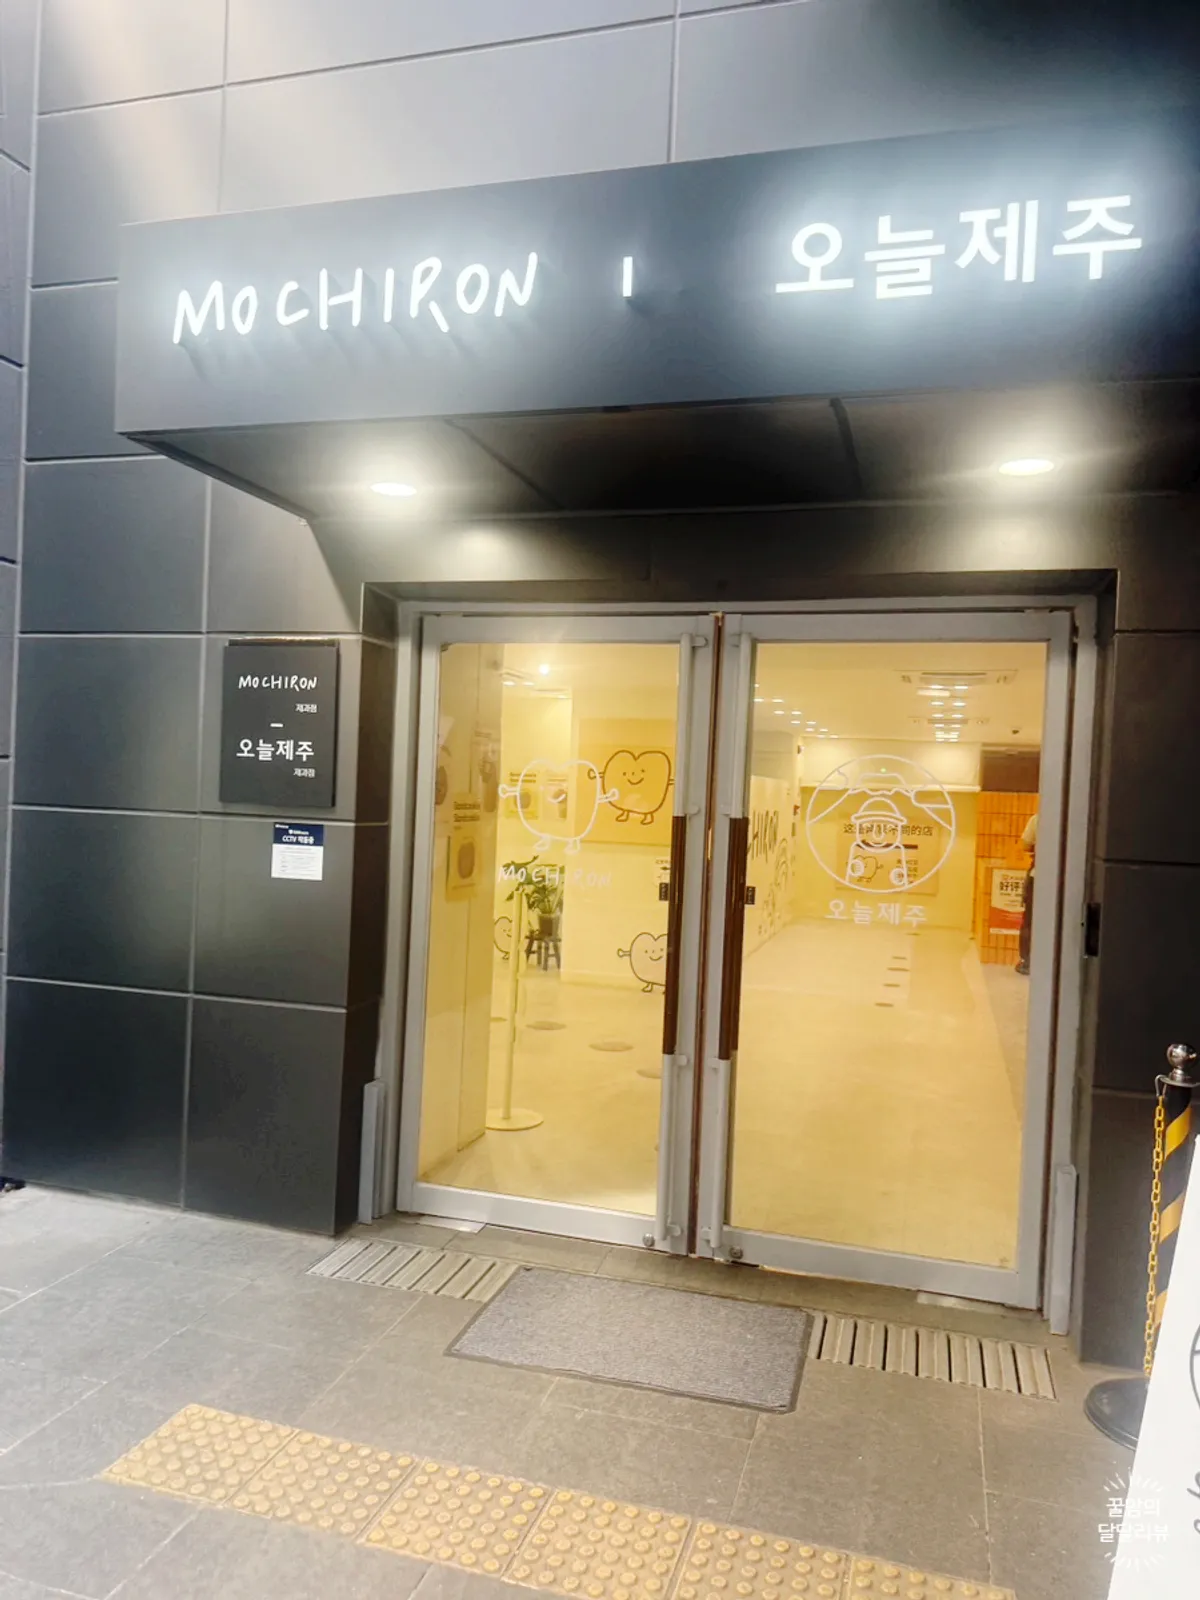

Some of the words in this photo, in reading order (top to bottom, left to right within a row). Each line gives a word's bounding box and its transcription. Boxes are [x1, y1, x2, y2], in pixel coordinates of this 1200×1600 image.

[775, 195, 1142, 300] 오늘제주
[173, 252, 538, 344] MOCHIRON
[238, 675, 318, 691] MOCHIRON
[236, 739, 315, 761] 오늘제주
[825, 899, 927, 927] 오늘제주
